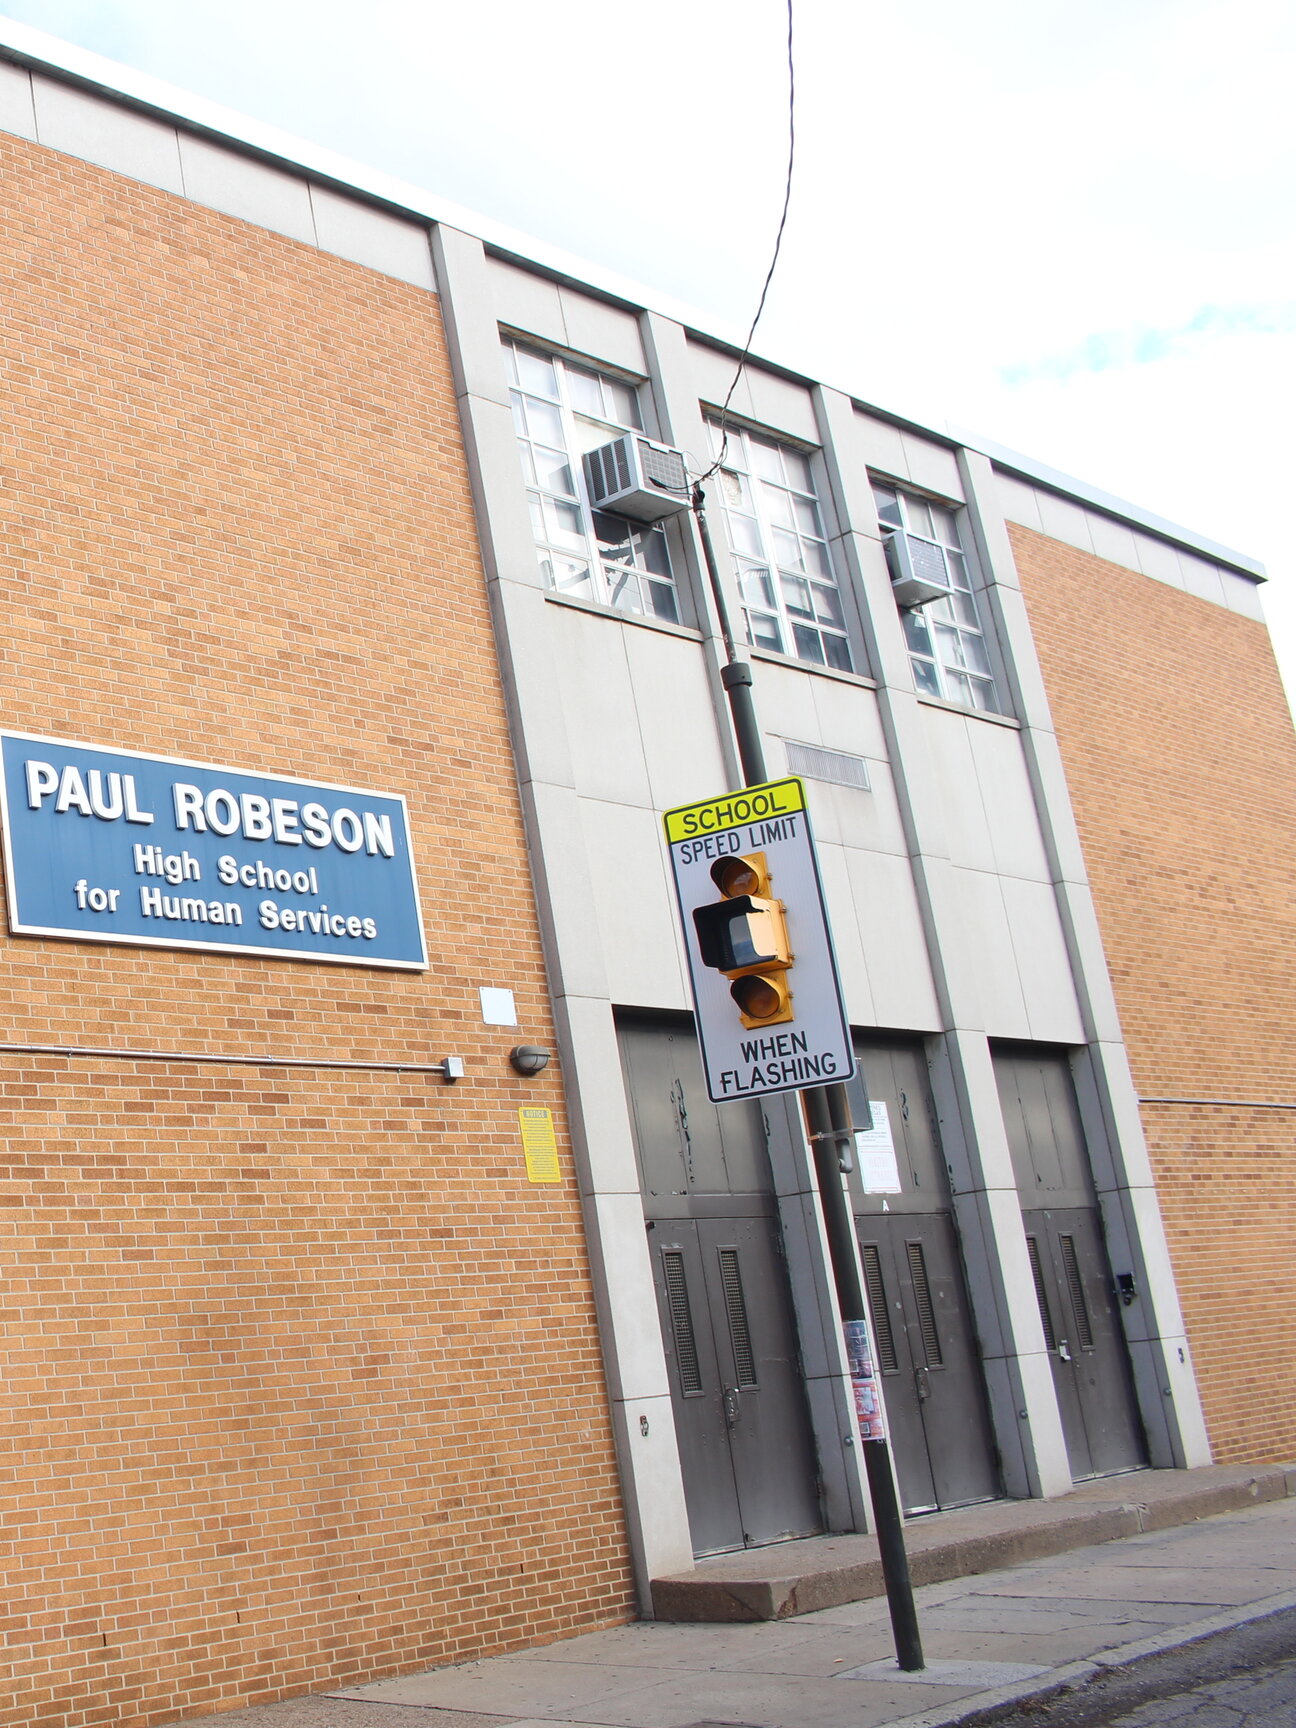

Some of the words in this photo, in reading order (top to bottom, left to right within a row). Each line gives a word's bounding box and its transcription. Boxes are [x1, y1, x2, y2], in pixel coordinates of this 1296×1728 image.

[24, 759, 154, 825] PAUL
[172, 782, 395, 858] ROBESON
[682, 791, 787, 834] SCHOOL
[680, 831, 741, 865] SPEED
[748, 816, 797, 848] LIMIT
[133, 843, 201, 885] High
[217, 855, 318, 895] School
[74, 879, 120, 912] for
[139, 886, 242, 926] Human
[259, 900, 377, 939] Services
[740, 1031, 808, 1063] WHEN
[720, 1052, 836, 1094] FLASHING
[882, 1199, 890, 1212] A
